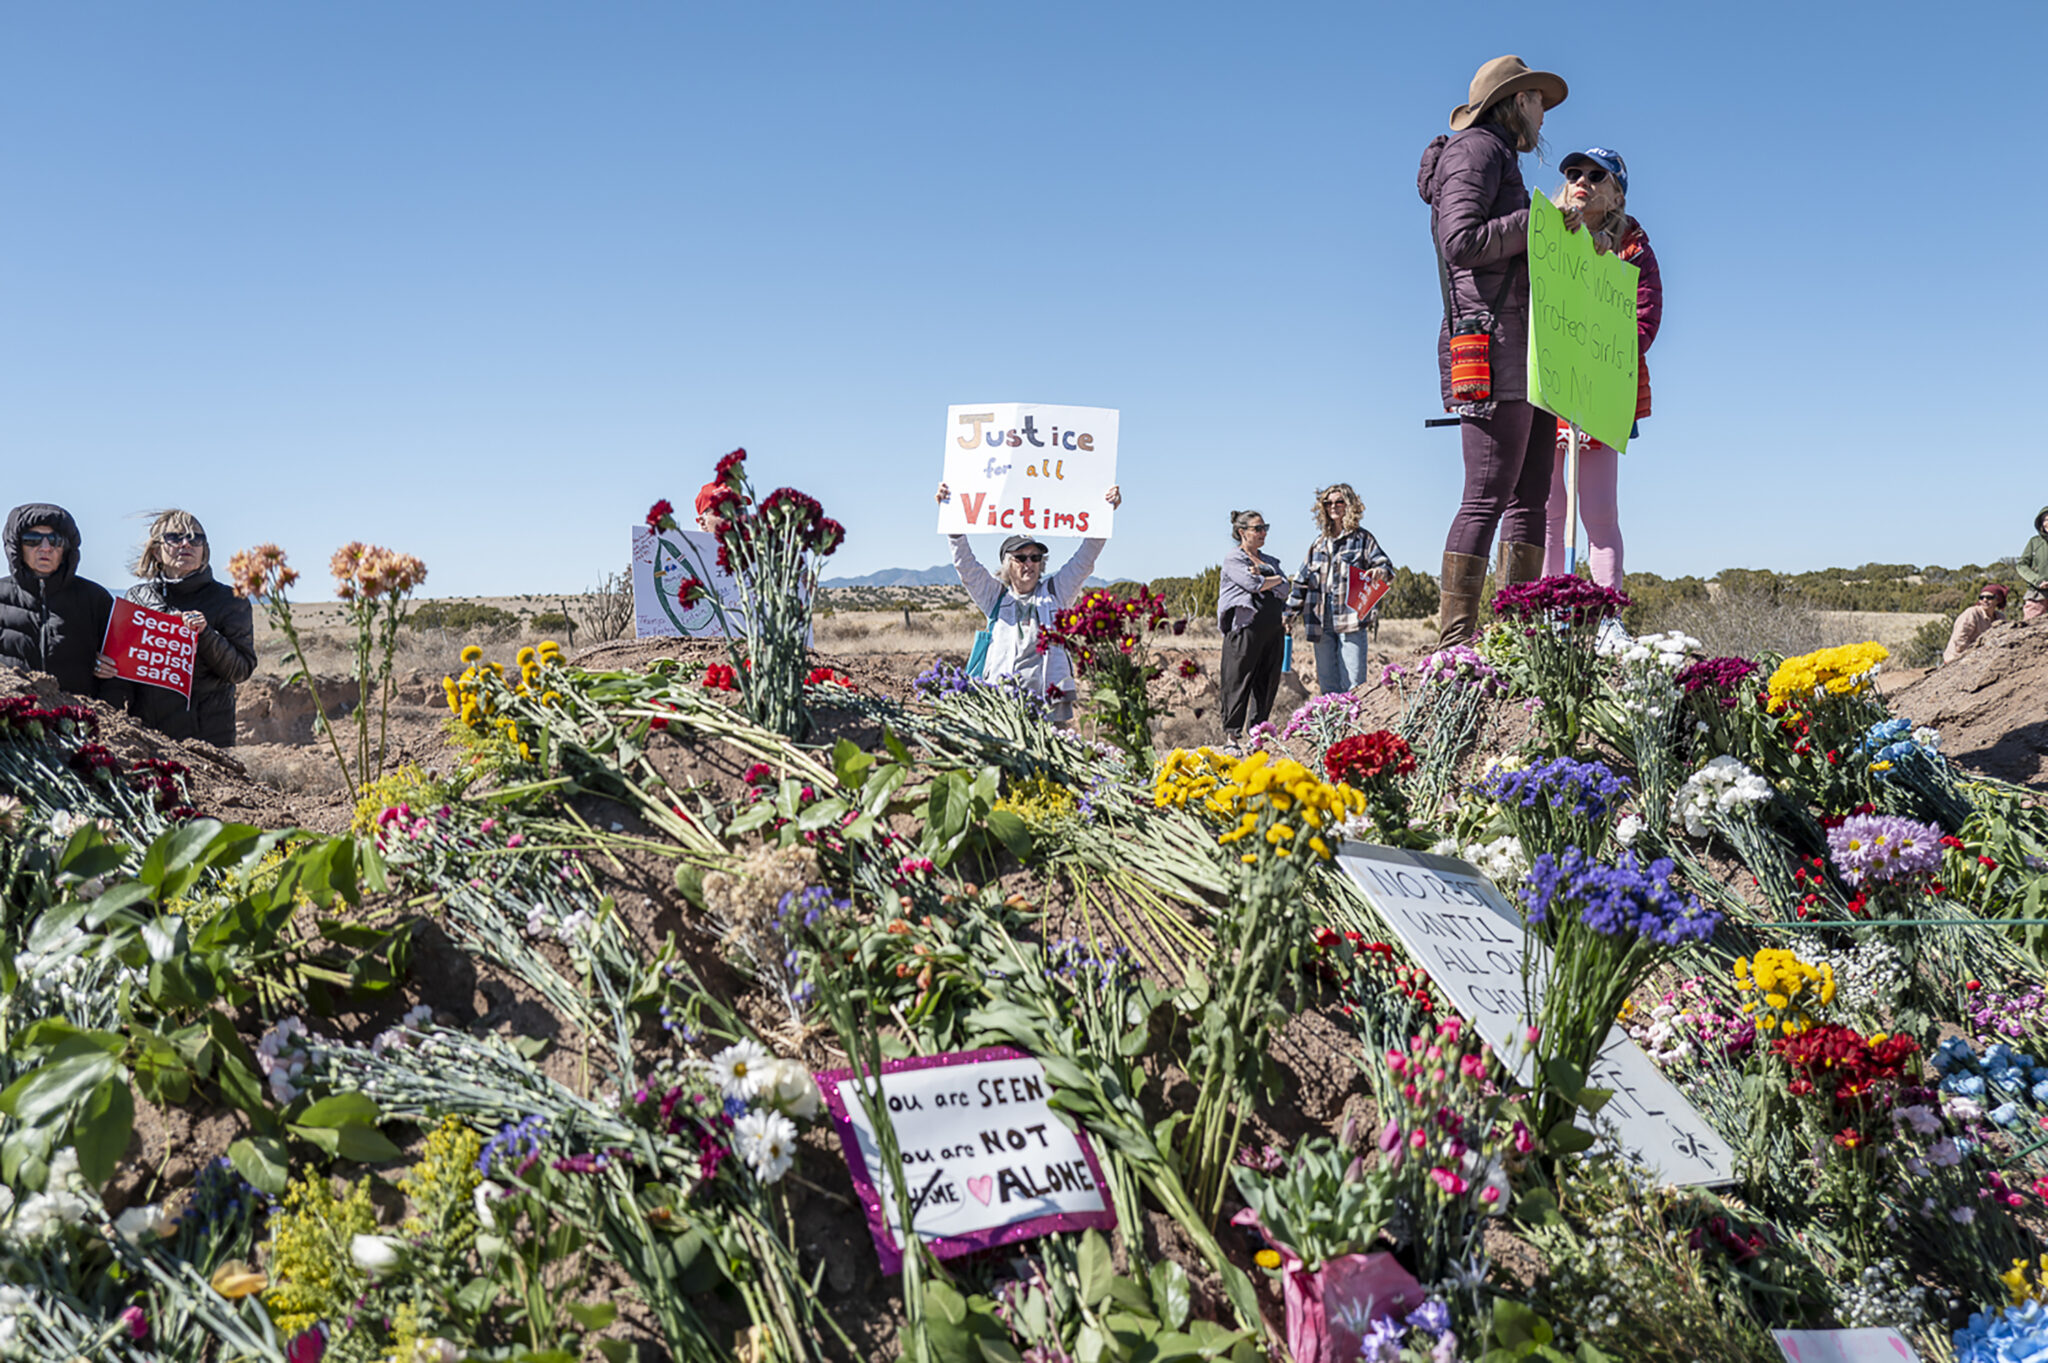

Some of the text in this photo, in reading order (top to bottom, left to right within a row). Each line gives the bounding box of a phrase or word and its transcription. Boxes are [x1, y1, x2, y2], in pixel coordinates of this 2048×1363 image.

[1533, 208, 1590, 290] Belive
[957, 412, 1095, 452] Justice
[983, 456, 1064, 481] for all
[960, 491, 1090, 533] Victims
[141, 629, 192, 657] keep
[136, 665, 184, 687] safe.
[1367, 866, 1492, 908] NO REST
[1402, 908, 1515, 944] UNTIL
[1433, 944, 1490, 975] ALL
[935, 1091, 970, 1108] are
[977, 1074, 1044, 1108] SEEN
[895, 1123, 1049, 1165] ou are NOT
[997, 1160, 1095, 1204] ALONE
